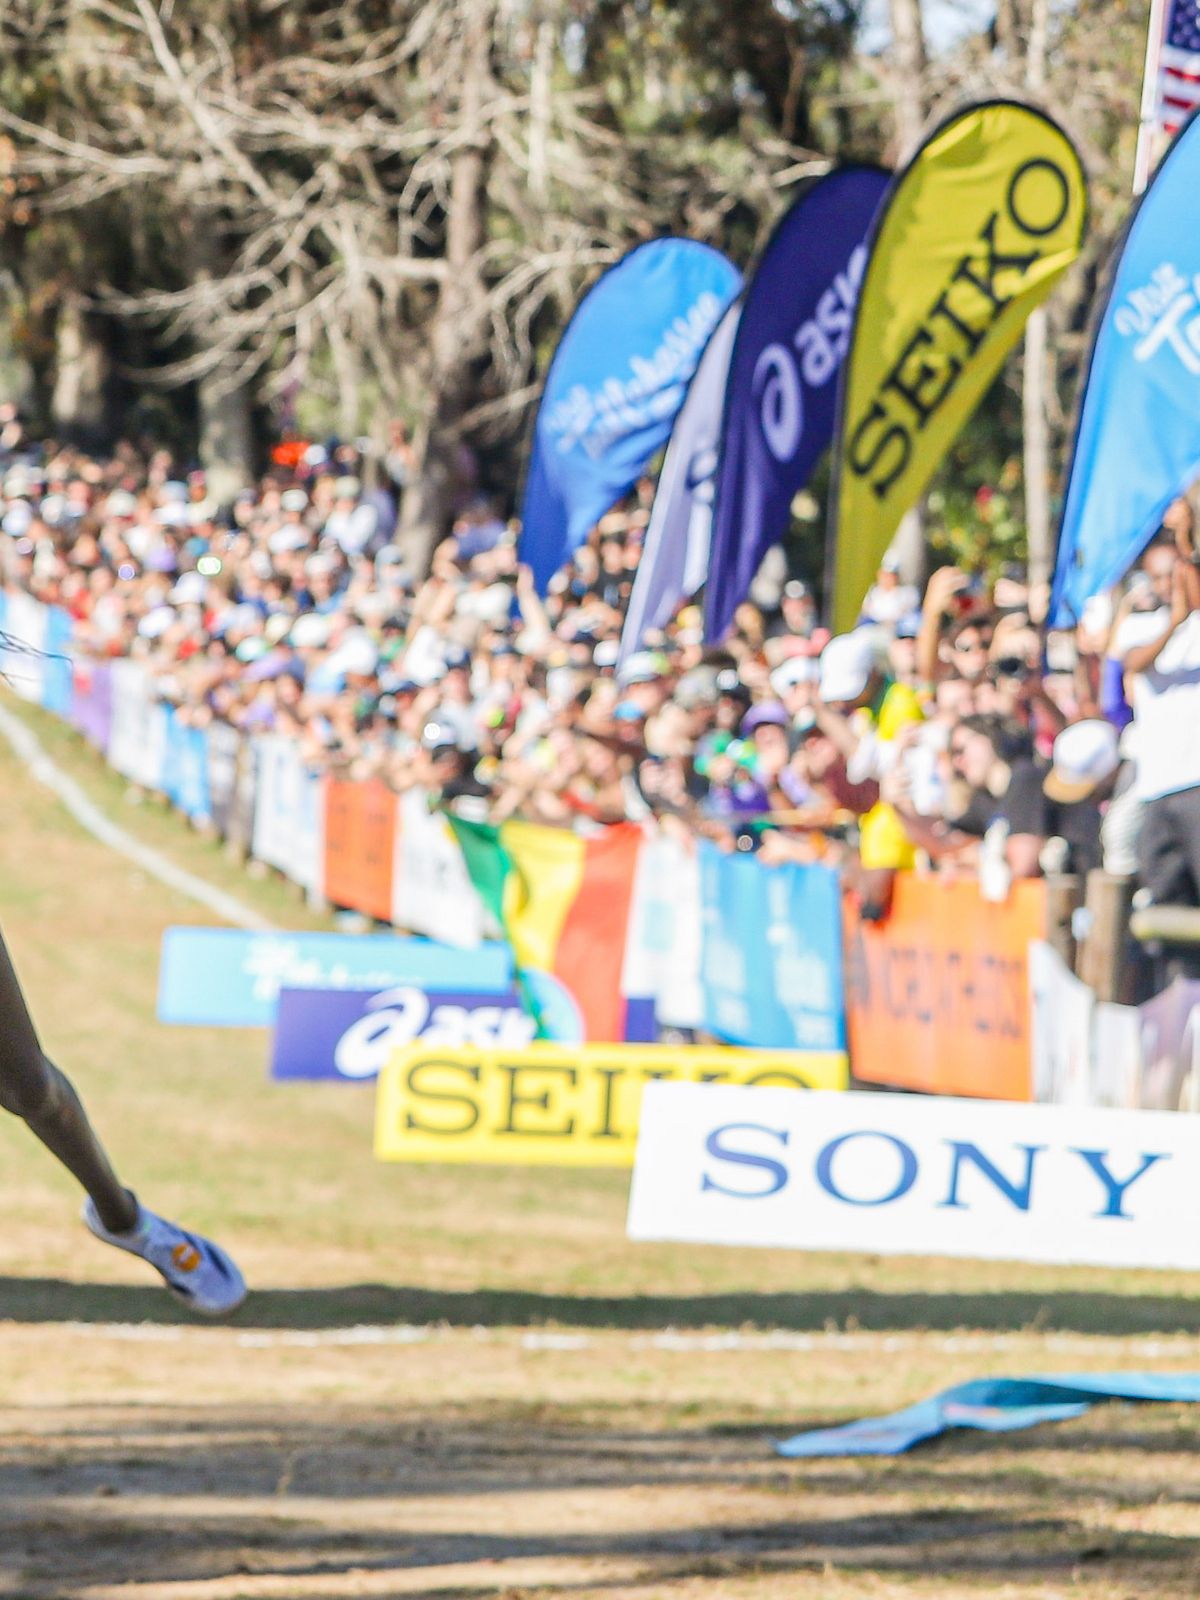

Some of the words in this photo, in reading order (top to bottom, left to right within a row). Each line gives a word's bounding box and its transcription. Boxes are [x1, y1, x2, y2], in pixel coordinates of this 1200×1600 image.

[849, 157, 1069, 499] SEIKO
[404, 1059, 812, 1139] SEI
[701, 1122, 1173, 1222] SONY
